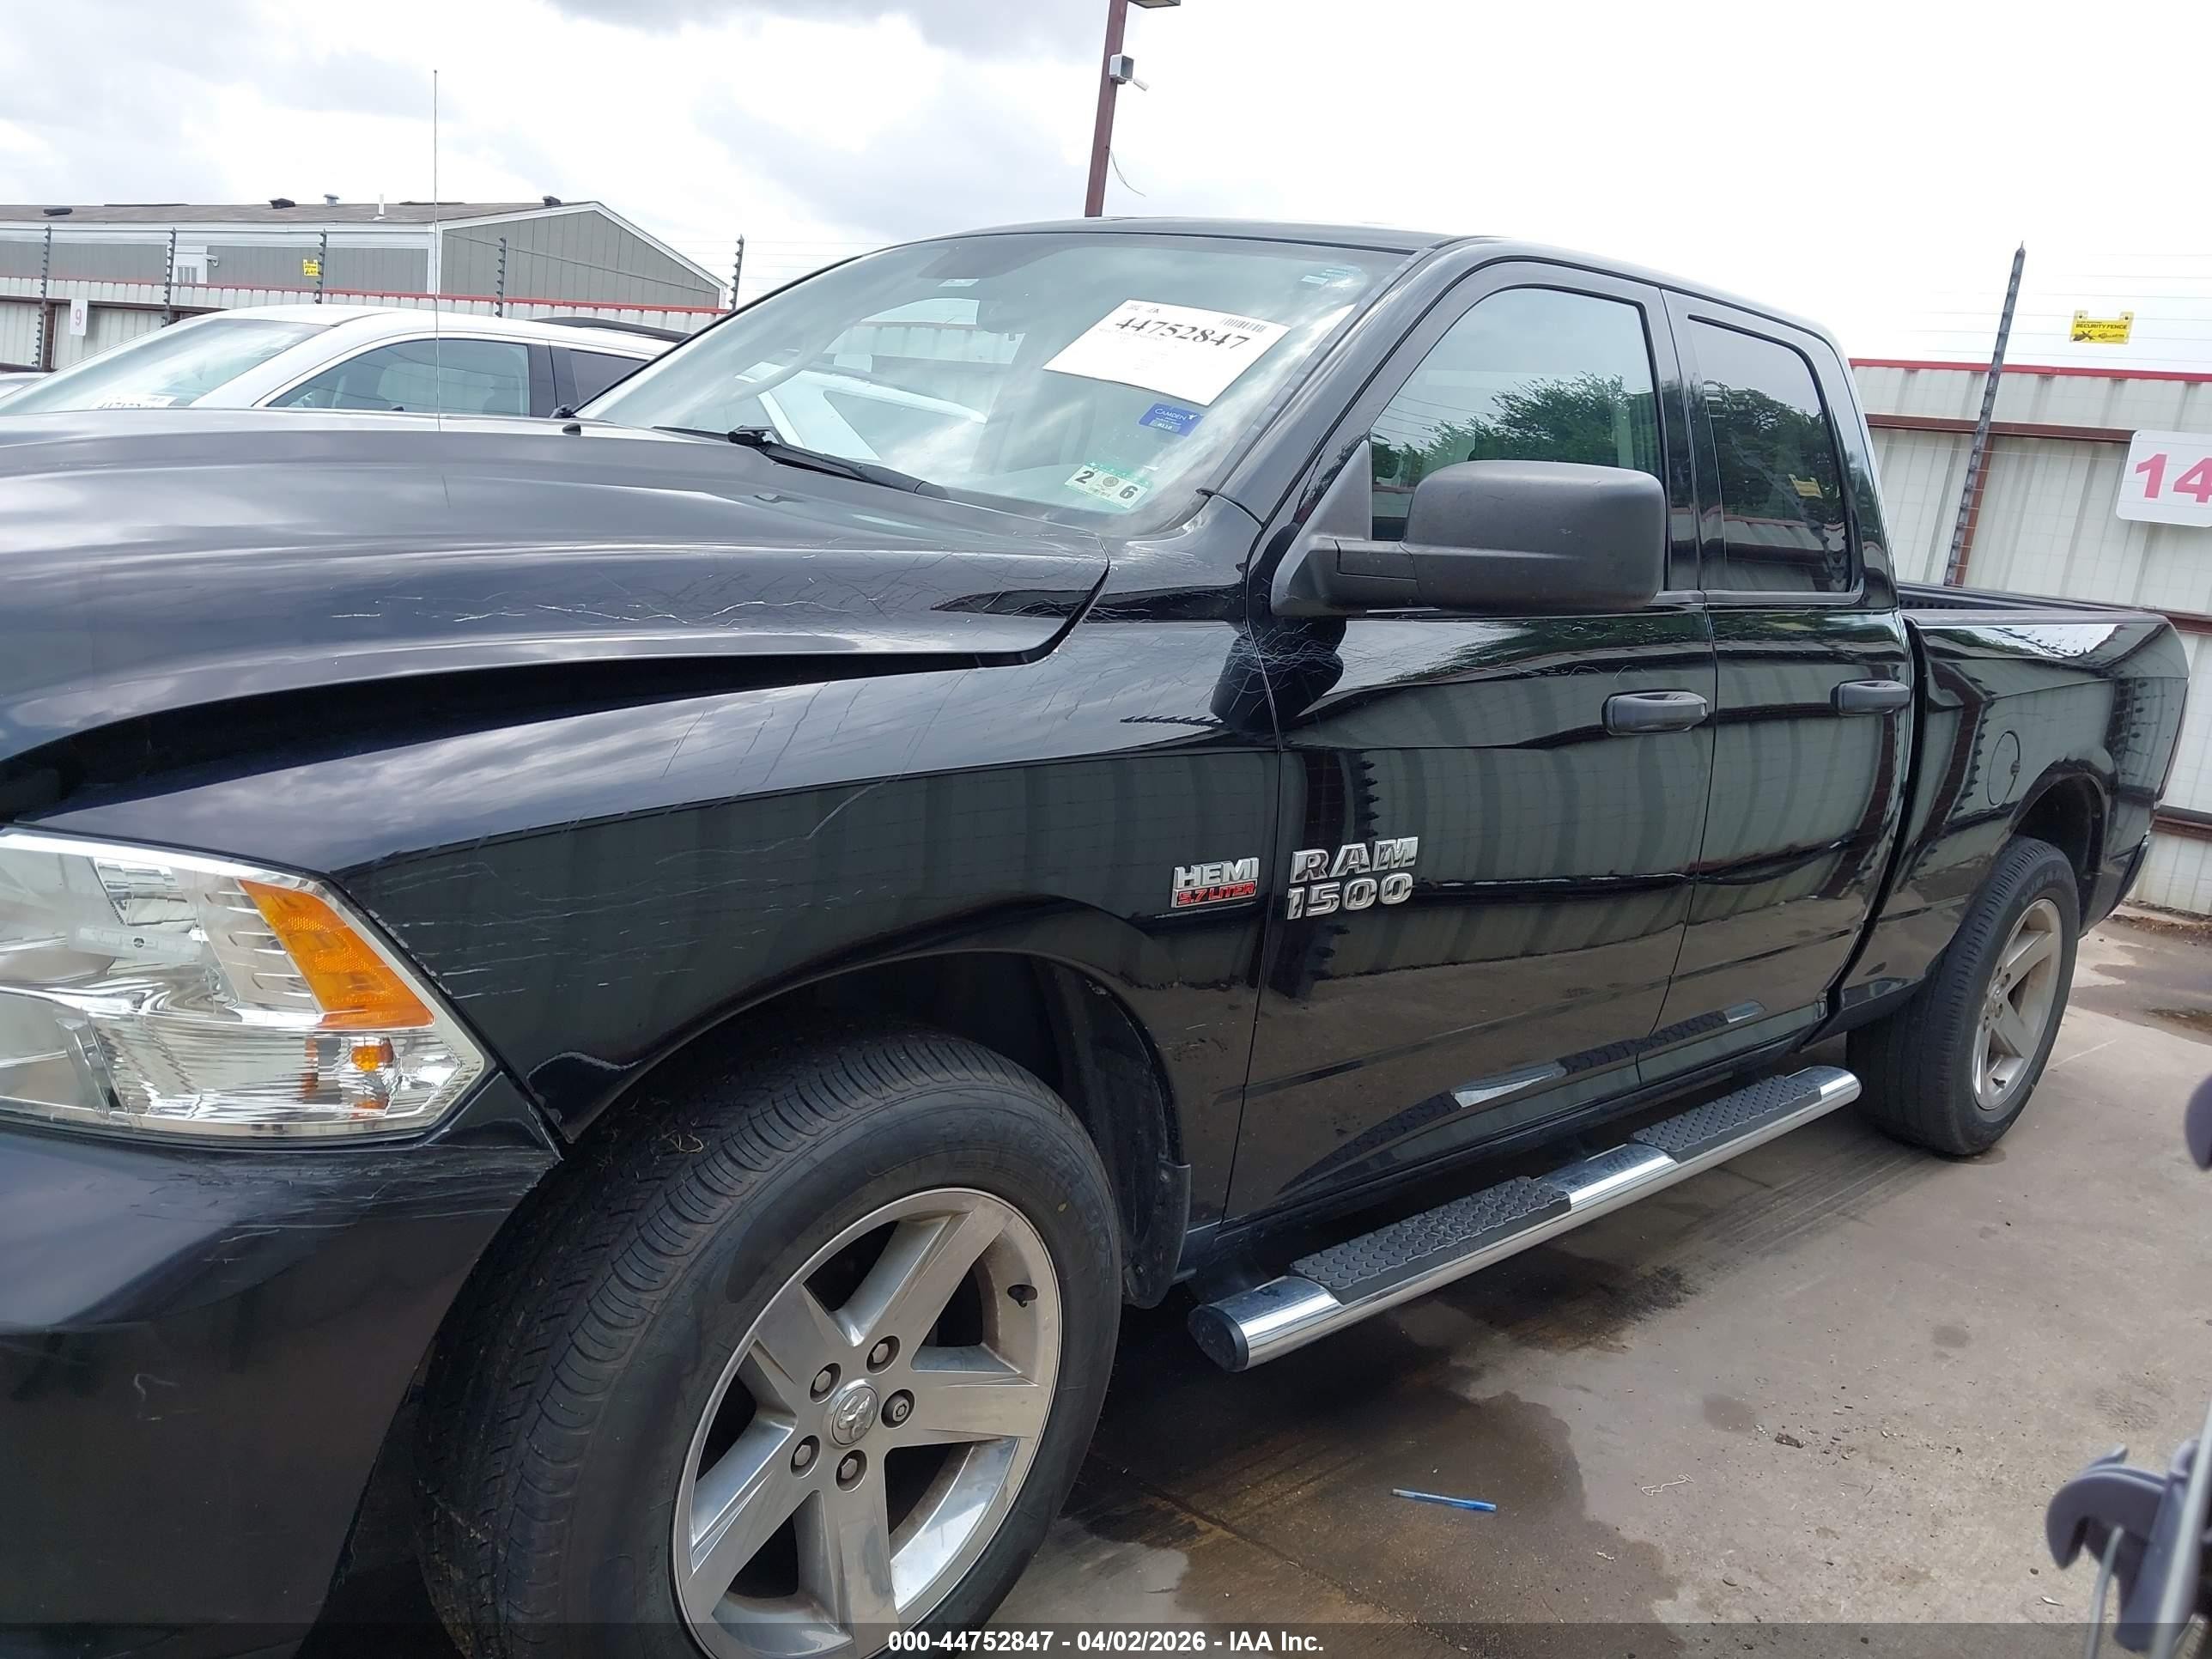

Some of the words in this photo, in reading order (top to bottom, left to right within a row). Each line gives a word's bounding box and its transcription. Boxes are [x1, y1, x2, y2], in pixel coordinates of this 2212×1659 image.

[75, 308, 82, 326] 9
[1115, 318, 1251, 349] 44752847
[1154, 408, 1188, 421] CAMDEN
[1074, 470, 1095, 484] 2
[1119, 485, 1139, 500] 6
[2135, 453, 2212, 504] 14
[1174, 857, 1260, 890] HEMI
[1290, 836, 1419, 884] RAM
[1177, 889, 1206, 906] 5.7
[1208, 881, 1256, 900] LITER
[1286, 872, 1414, 921] 1500
